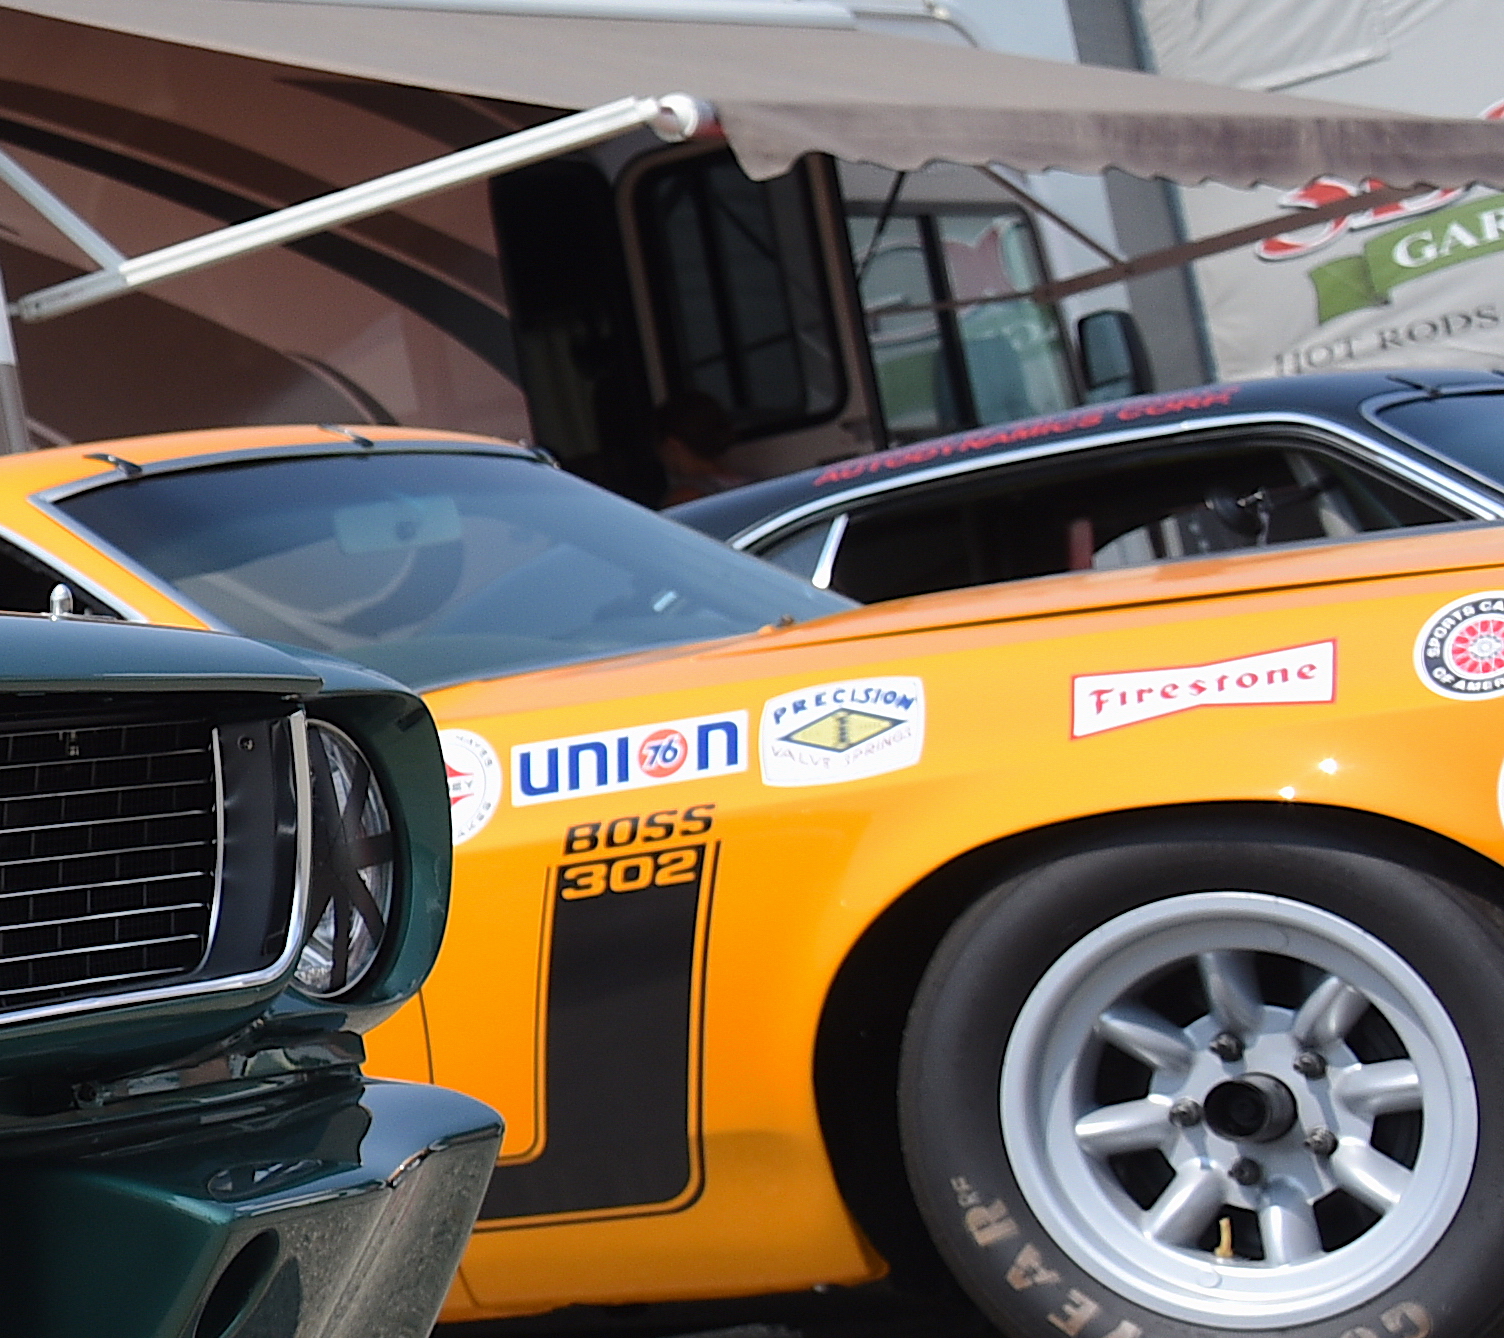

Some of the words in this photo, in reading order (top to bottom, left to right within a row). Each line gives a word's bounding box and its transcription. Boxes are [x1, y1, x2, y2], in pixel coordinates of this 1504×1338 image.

[1274, 338, 1354, 375] HOT
[1377, 304, 1499, 350] RODS
[773, 687, 916, 725] PRECISION
[1089, 664, 1317, 715] Firestone
[562, 804, 716, 856] BOSS
[561, 849, 697, 901] 302
